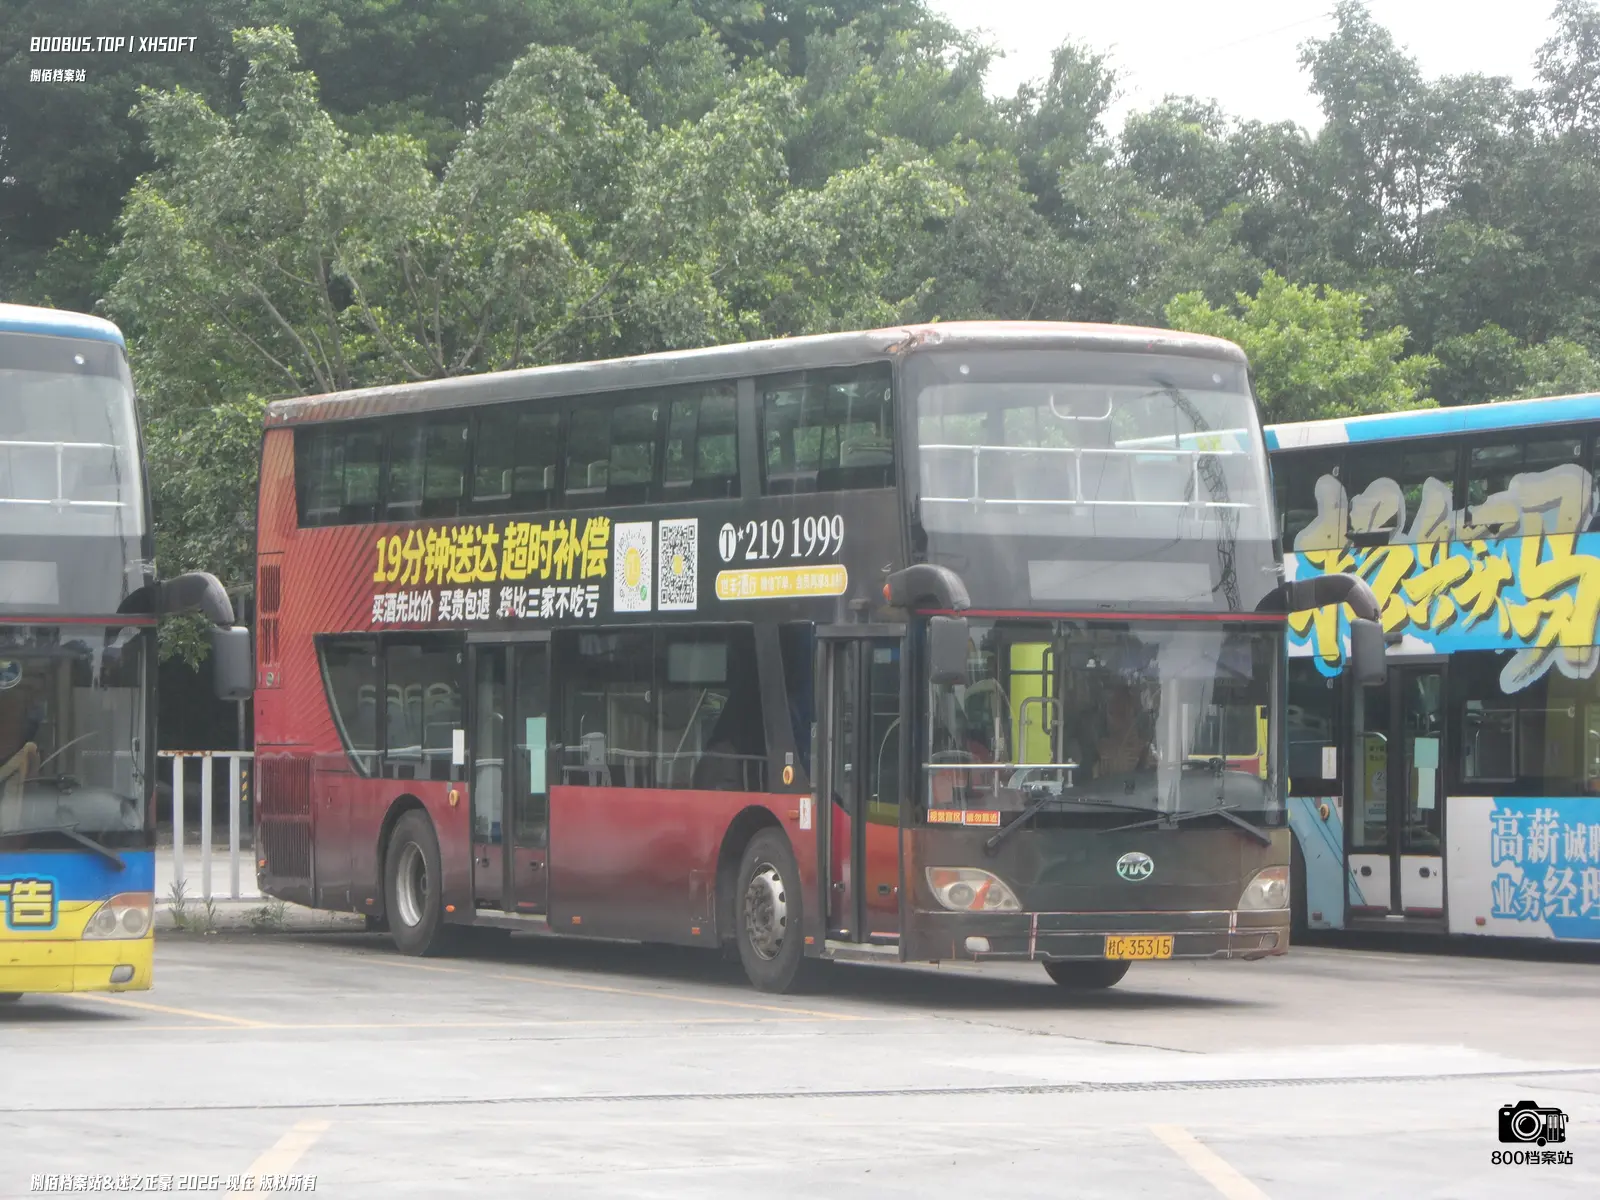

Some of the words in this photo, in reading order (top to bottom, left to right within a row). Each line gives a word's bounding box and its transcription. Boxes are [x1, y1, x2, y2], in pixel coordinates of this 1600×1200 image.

[372, 523, 500, 586] 19分钟送达
[500, 516, 611, 581] 超时补偿
[791, 514, 845, 557] 1999
[371, 591, 434, 623] 买酒先比价
[438, 587, 491, 621] 买贵包退
[496, 584, 600, 619] 货比三家不吃亏
